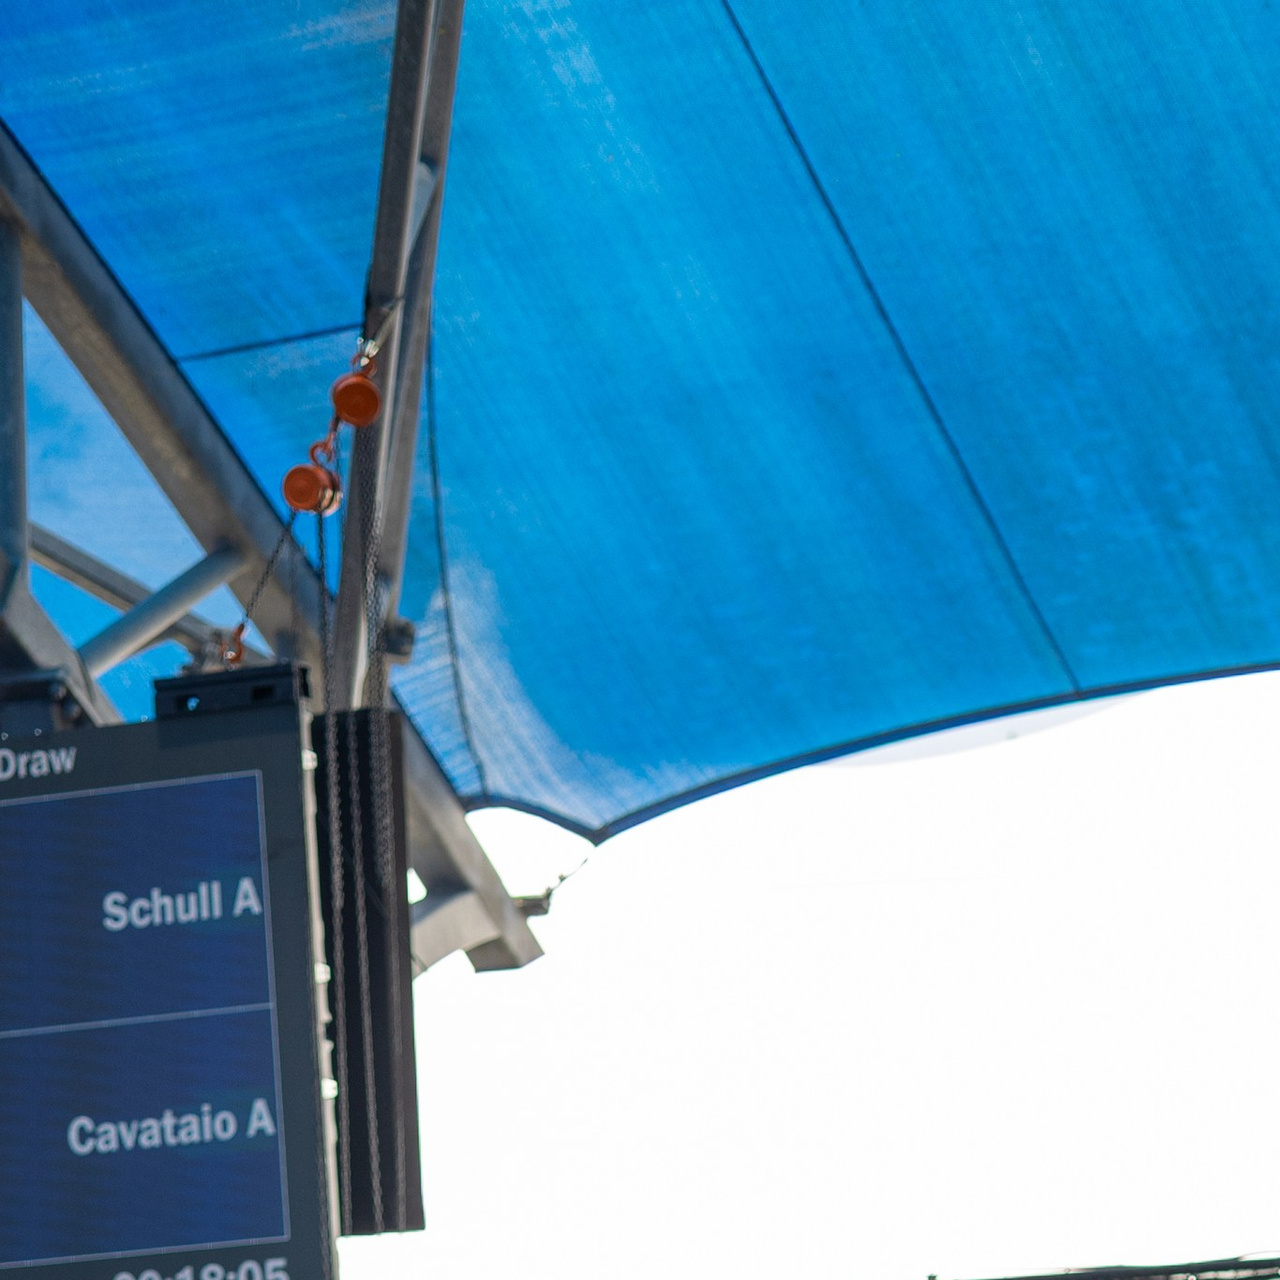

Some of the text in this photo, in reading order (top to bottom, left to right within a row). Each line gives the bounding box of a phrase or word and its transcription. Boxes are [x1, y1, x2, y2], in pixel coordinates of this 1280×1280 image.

[0, 746, 77, 780] Draw
[102, 876, 263, 932] Schull A
[67, 1097, 276, 1156] Cavataio A
